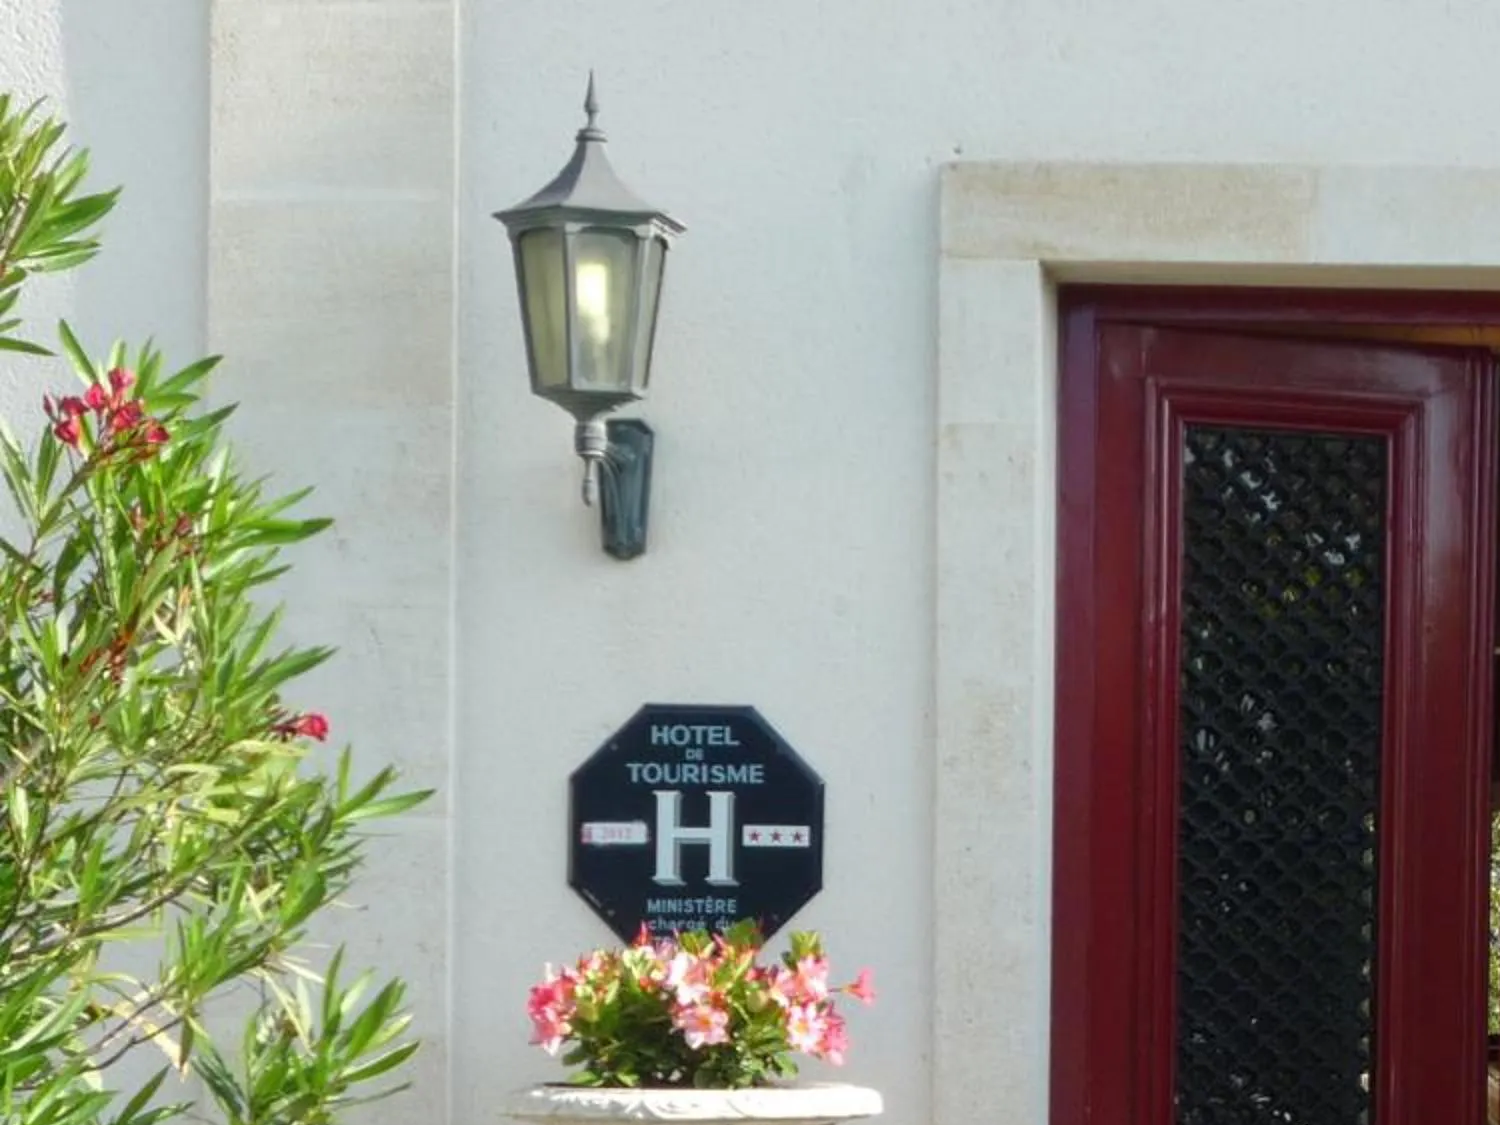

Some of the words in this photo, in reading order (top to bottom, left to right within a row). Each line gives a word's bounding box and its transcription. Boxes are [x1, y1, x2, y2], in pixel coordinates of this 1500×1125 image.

[651, 724, 740, 746] HOTEL
[685, 748, 704, 761] DE
[626, 763, 765, 784] TOURISME
[651, 790, 741, 886] H
[647, 896, 737, 914] MINISTÈRE
